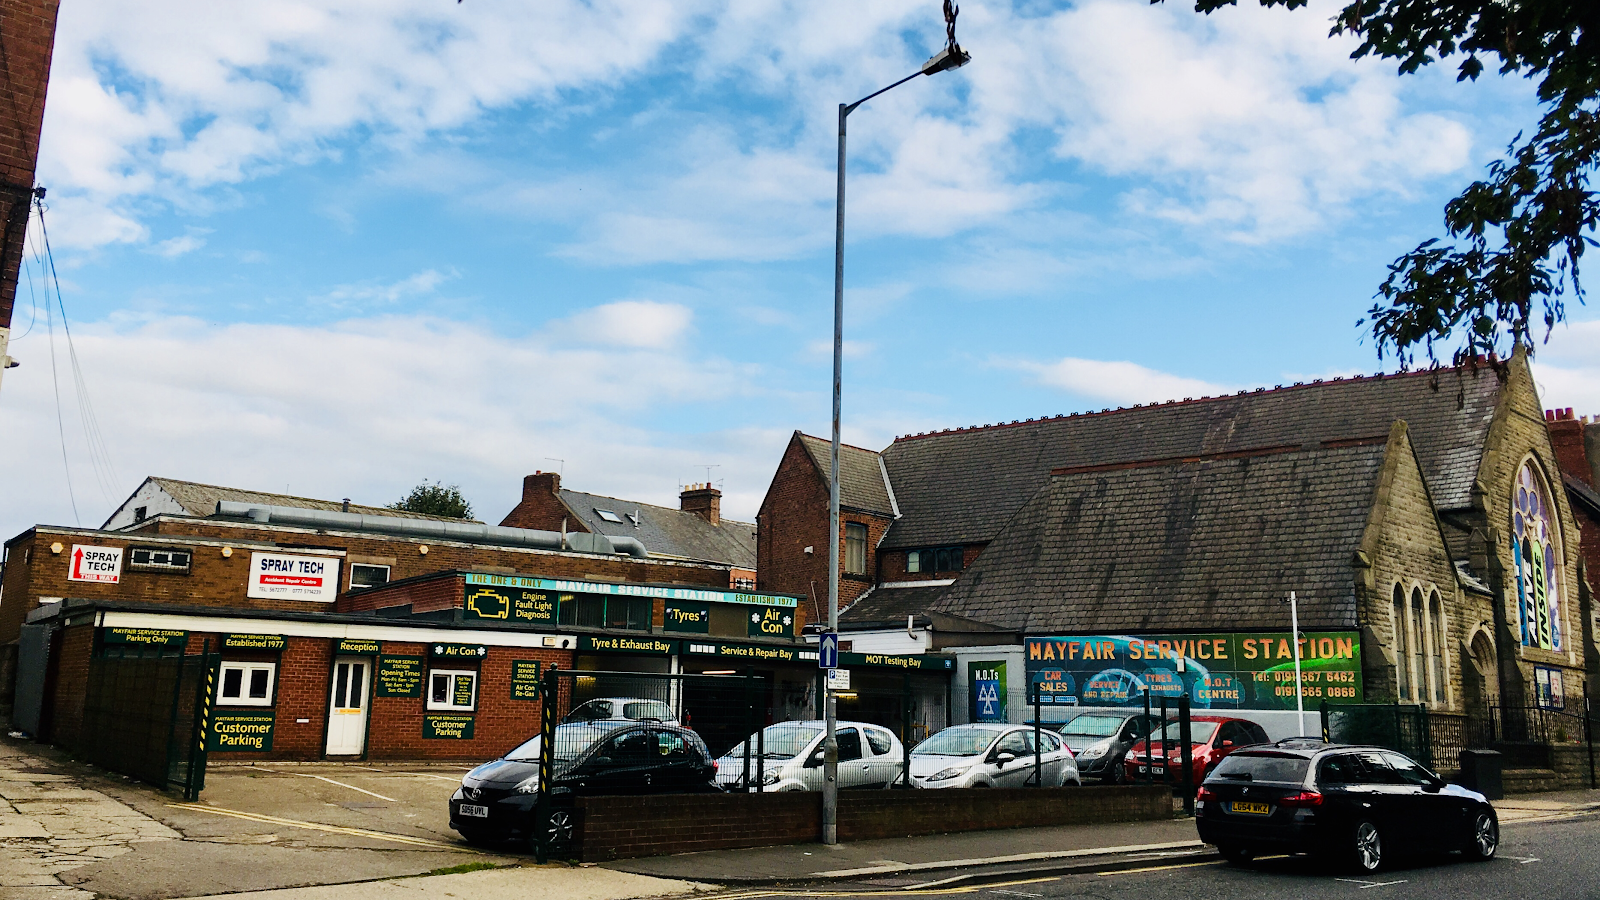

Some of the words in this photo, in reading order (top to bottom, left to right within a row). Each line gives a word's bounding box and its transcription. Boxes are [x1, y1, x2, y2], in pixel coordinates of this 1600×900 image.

[86, 552, 119, 562] SPRAY
[88, 562, 115, 572] TECH
[261, 558, 294, 572] SPRAY
[299, 561, 324, 574] TECH
[472, 574, 488, 583] THE
[490, 576, 507, 585] ONE
[511, 577, 517, 586] &
[520, 578, 542, 587] ONLY
[556, 581, 612, 594] MAYFAIR
[618, 586, 668, 597] SERVICE
[674, 590, 724, 600] STATION
[522, 592, 546, 601] Engine
[1524, 558, 1538, 643] ALIVE
[1535, 552, 1550, 645] INSIDE
[515, 600, 533, 609] Fault
[534, 602, 552, 611] Light
[516, 610, 550, 620] Diagnosis
[673, 609, 699, 623] Tyres
[764, 609, 780, 621] Air
[761, 620, 783, 633] Con
[126, 635, 151, 643] Parking
[152, 635, 168, 644] Only
[226, 639, 266, 647] Established
[340, 642, 378, 652] Reception
[592, 638, 610, 650] Tyre
[612, 640, 618, 648] &
[620, 640, 653, 650] Exhaust
[655, 641, 670, 653] Bay
[1029, 641, 1116, 661] MAYFAIR
[1129, 639, 1228, 660] SERVICE
[1242, 637, 1353, 660] STATION
[446, 646, 458, 655] Air
[460, 647, 476, 656] Con
[721, 646, 747, 656] Service
[755, 649, 778, 659] Repair
[779, 650, 792, 660] Bay
[866, 655, 882, 664] MOT
[884, 656, 907, 668] Testing
[909, 658, 921, 668] Bay
[976, 669, 998, 680] M.O.Ts
[1045, 672, 1061, 680] CAR
[1145, 674, 1172, 682] TYRES
[1252, 672, 1270, 682] Tel:
[1275, 672, 1295, 682] 0191
[1302, 672, 1320, 681] 567
[1327, 673, 1354, 682] 6462
[1039, 682, 1068, 692] SALES
[1204, 678, 1232, 687] M.O.T
[1198, 690, 1239, 699] CENTRE
[1275, 687, 1296, 696] 0191
[1301, 687, 1322, 696] 565
[1327, 688, 1356, 697] 0868
[214, 722, 271, 733] Customer
[436, 728, 462, 738] Parking
[220, 734, 263, 748] Parking
